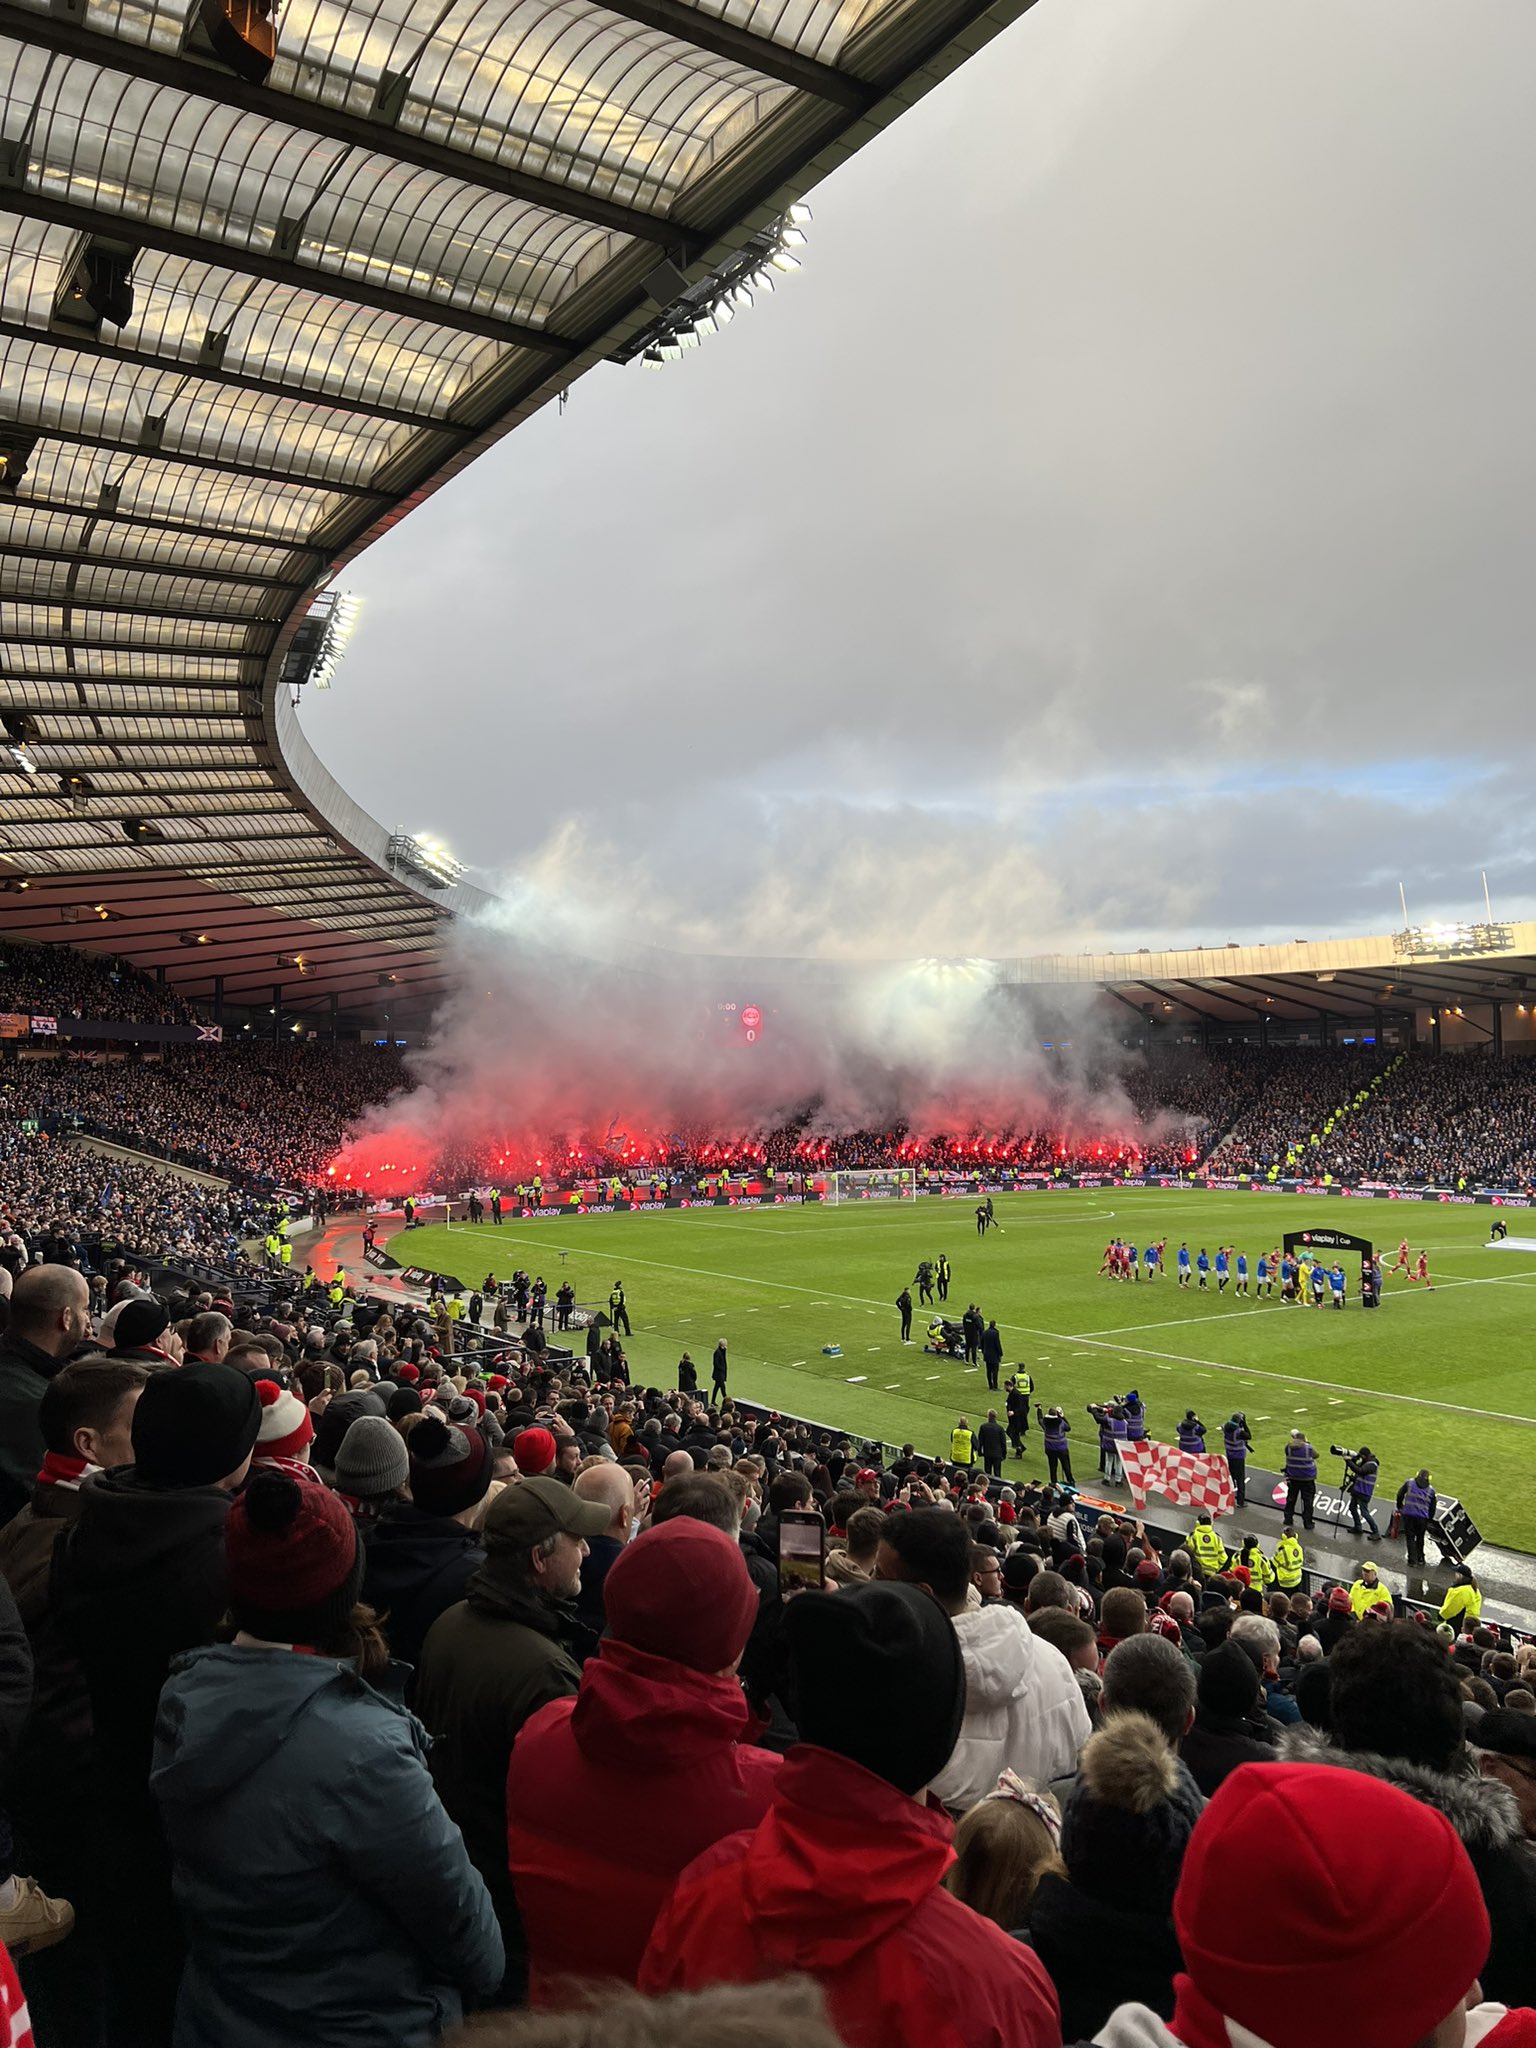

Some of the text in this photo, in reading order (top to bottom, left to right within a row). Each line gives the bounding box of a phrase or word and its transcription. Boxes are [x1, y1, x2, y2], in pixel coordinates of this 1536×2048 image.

[1121, 1178, 1146, 1188] viaplay
[1450, 1194, 1476, 1204] viaplay
[1503, 1197, 1531, 1208] viaplay
[587, 1204, 615, 1214] viaplay
[639, 1201, 666, 1211] viaplay
[532, 1207, 561, 1216] viaplay
[1311, 1233, 1351, 1245] viaplay Cup
